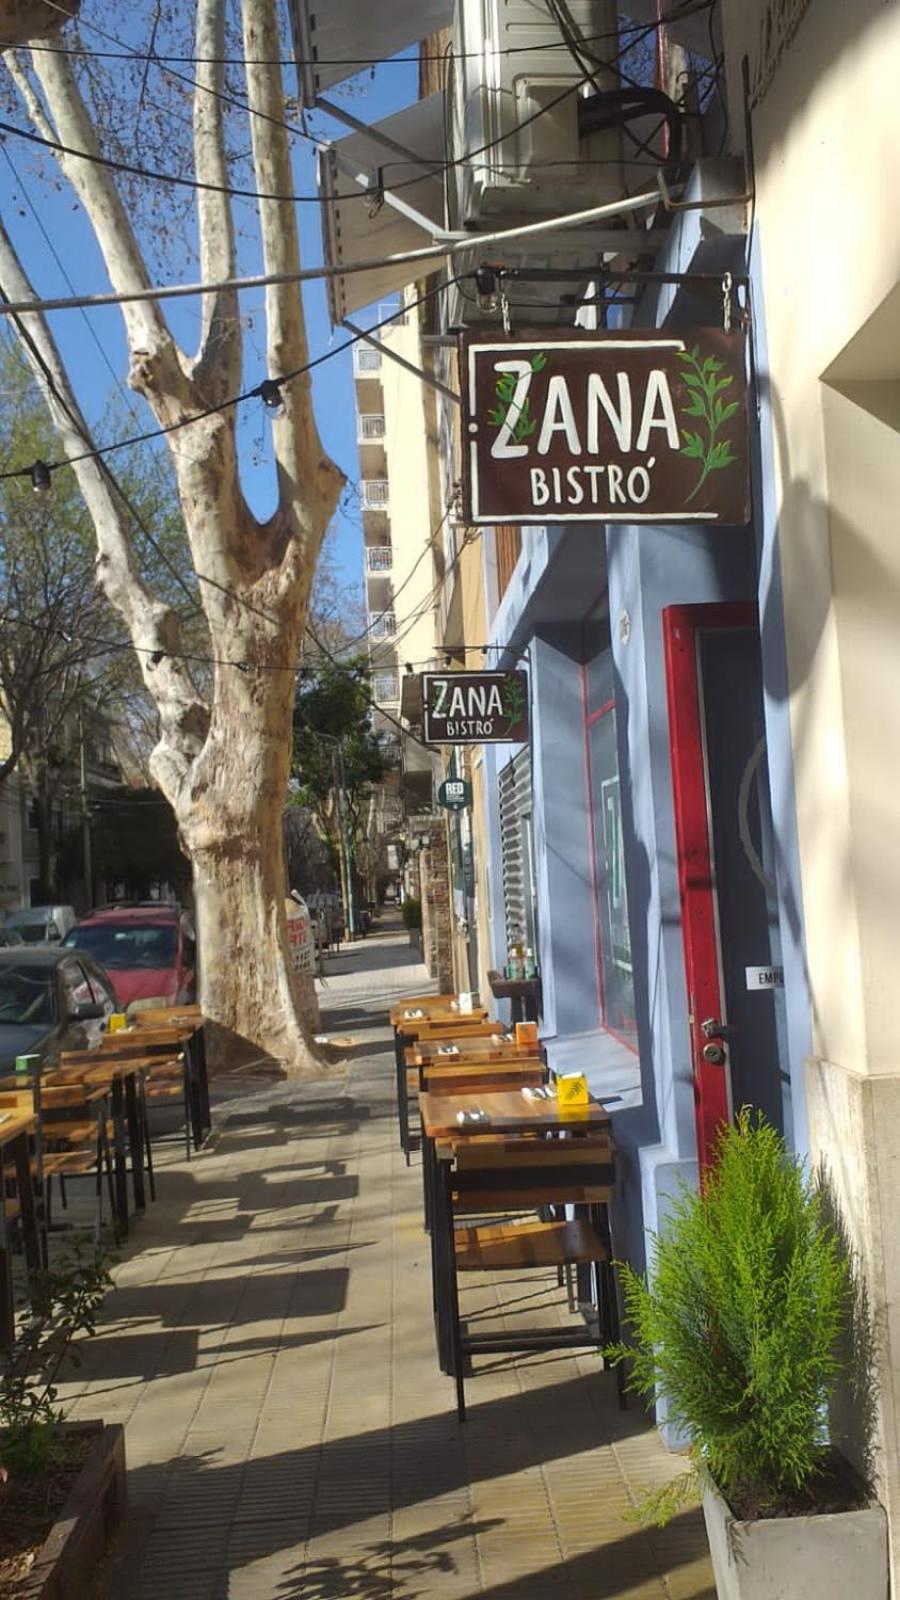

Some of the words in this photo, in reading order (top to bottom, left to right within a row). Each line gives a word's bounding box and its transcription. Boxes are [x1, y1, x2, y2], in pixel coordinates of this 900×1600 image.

[491, 360, 680, 459] ZANA
[530, 456, 655, 506] BISTRÓ
[432, 681, 503, 718] ZANA
[447, 718, 494, 735] BISTRÓ
